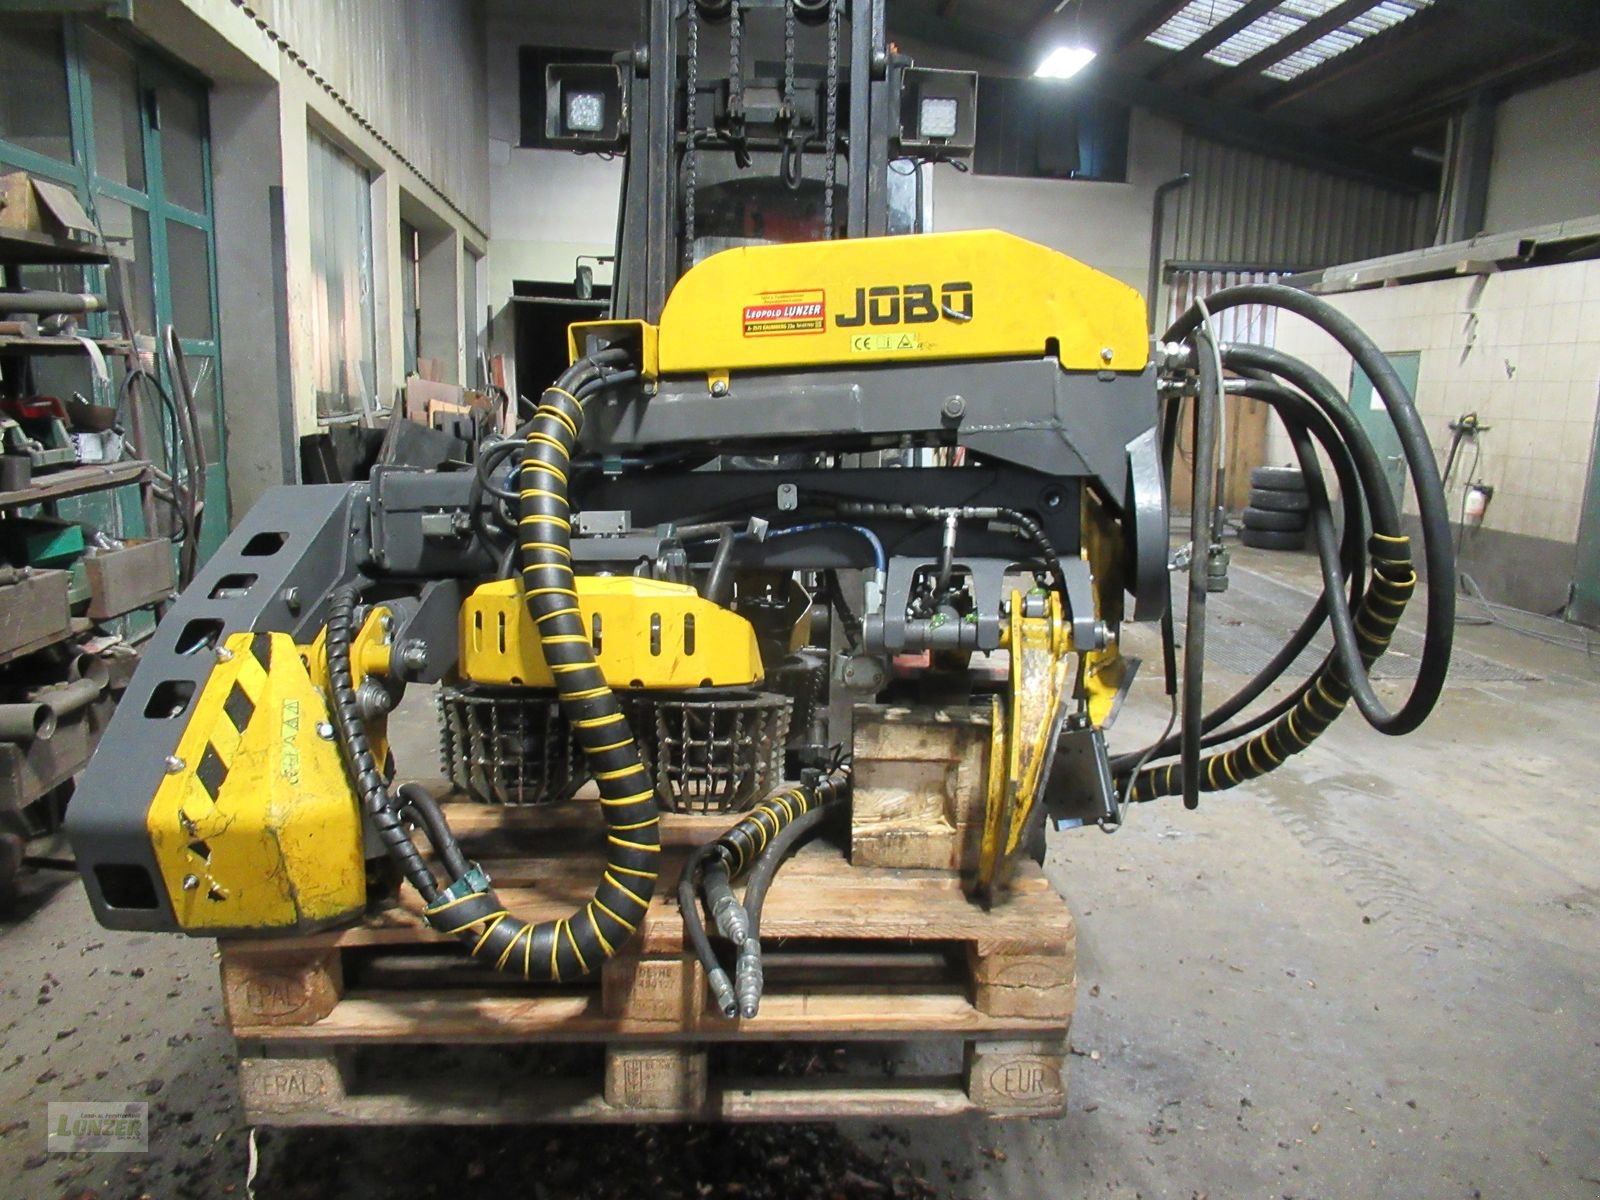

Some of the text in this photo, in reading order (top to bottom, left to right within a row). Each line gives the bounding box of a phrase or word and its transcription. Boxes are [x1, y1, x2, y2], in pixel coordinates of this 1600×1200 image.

[745, 304, 822, 319] LEOPOLD LUNZER
[835, 281, 973, 327] JOBO
[262, 1074, 313, 1096] EPAL
[1004, 1065, 1044, 1093] EUR
